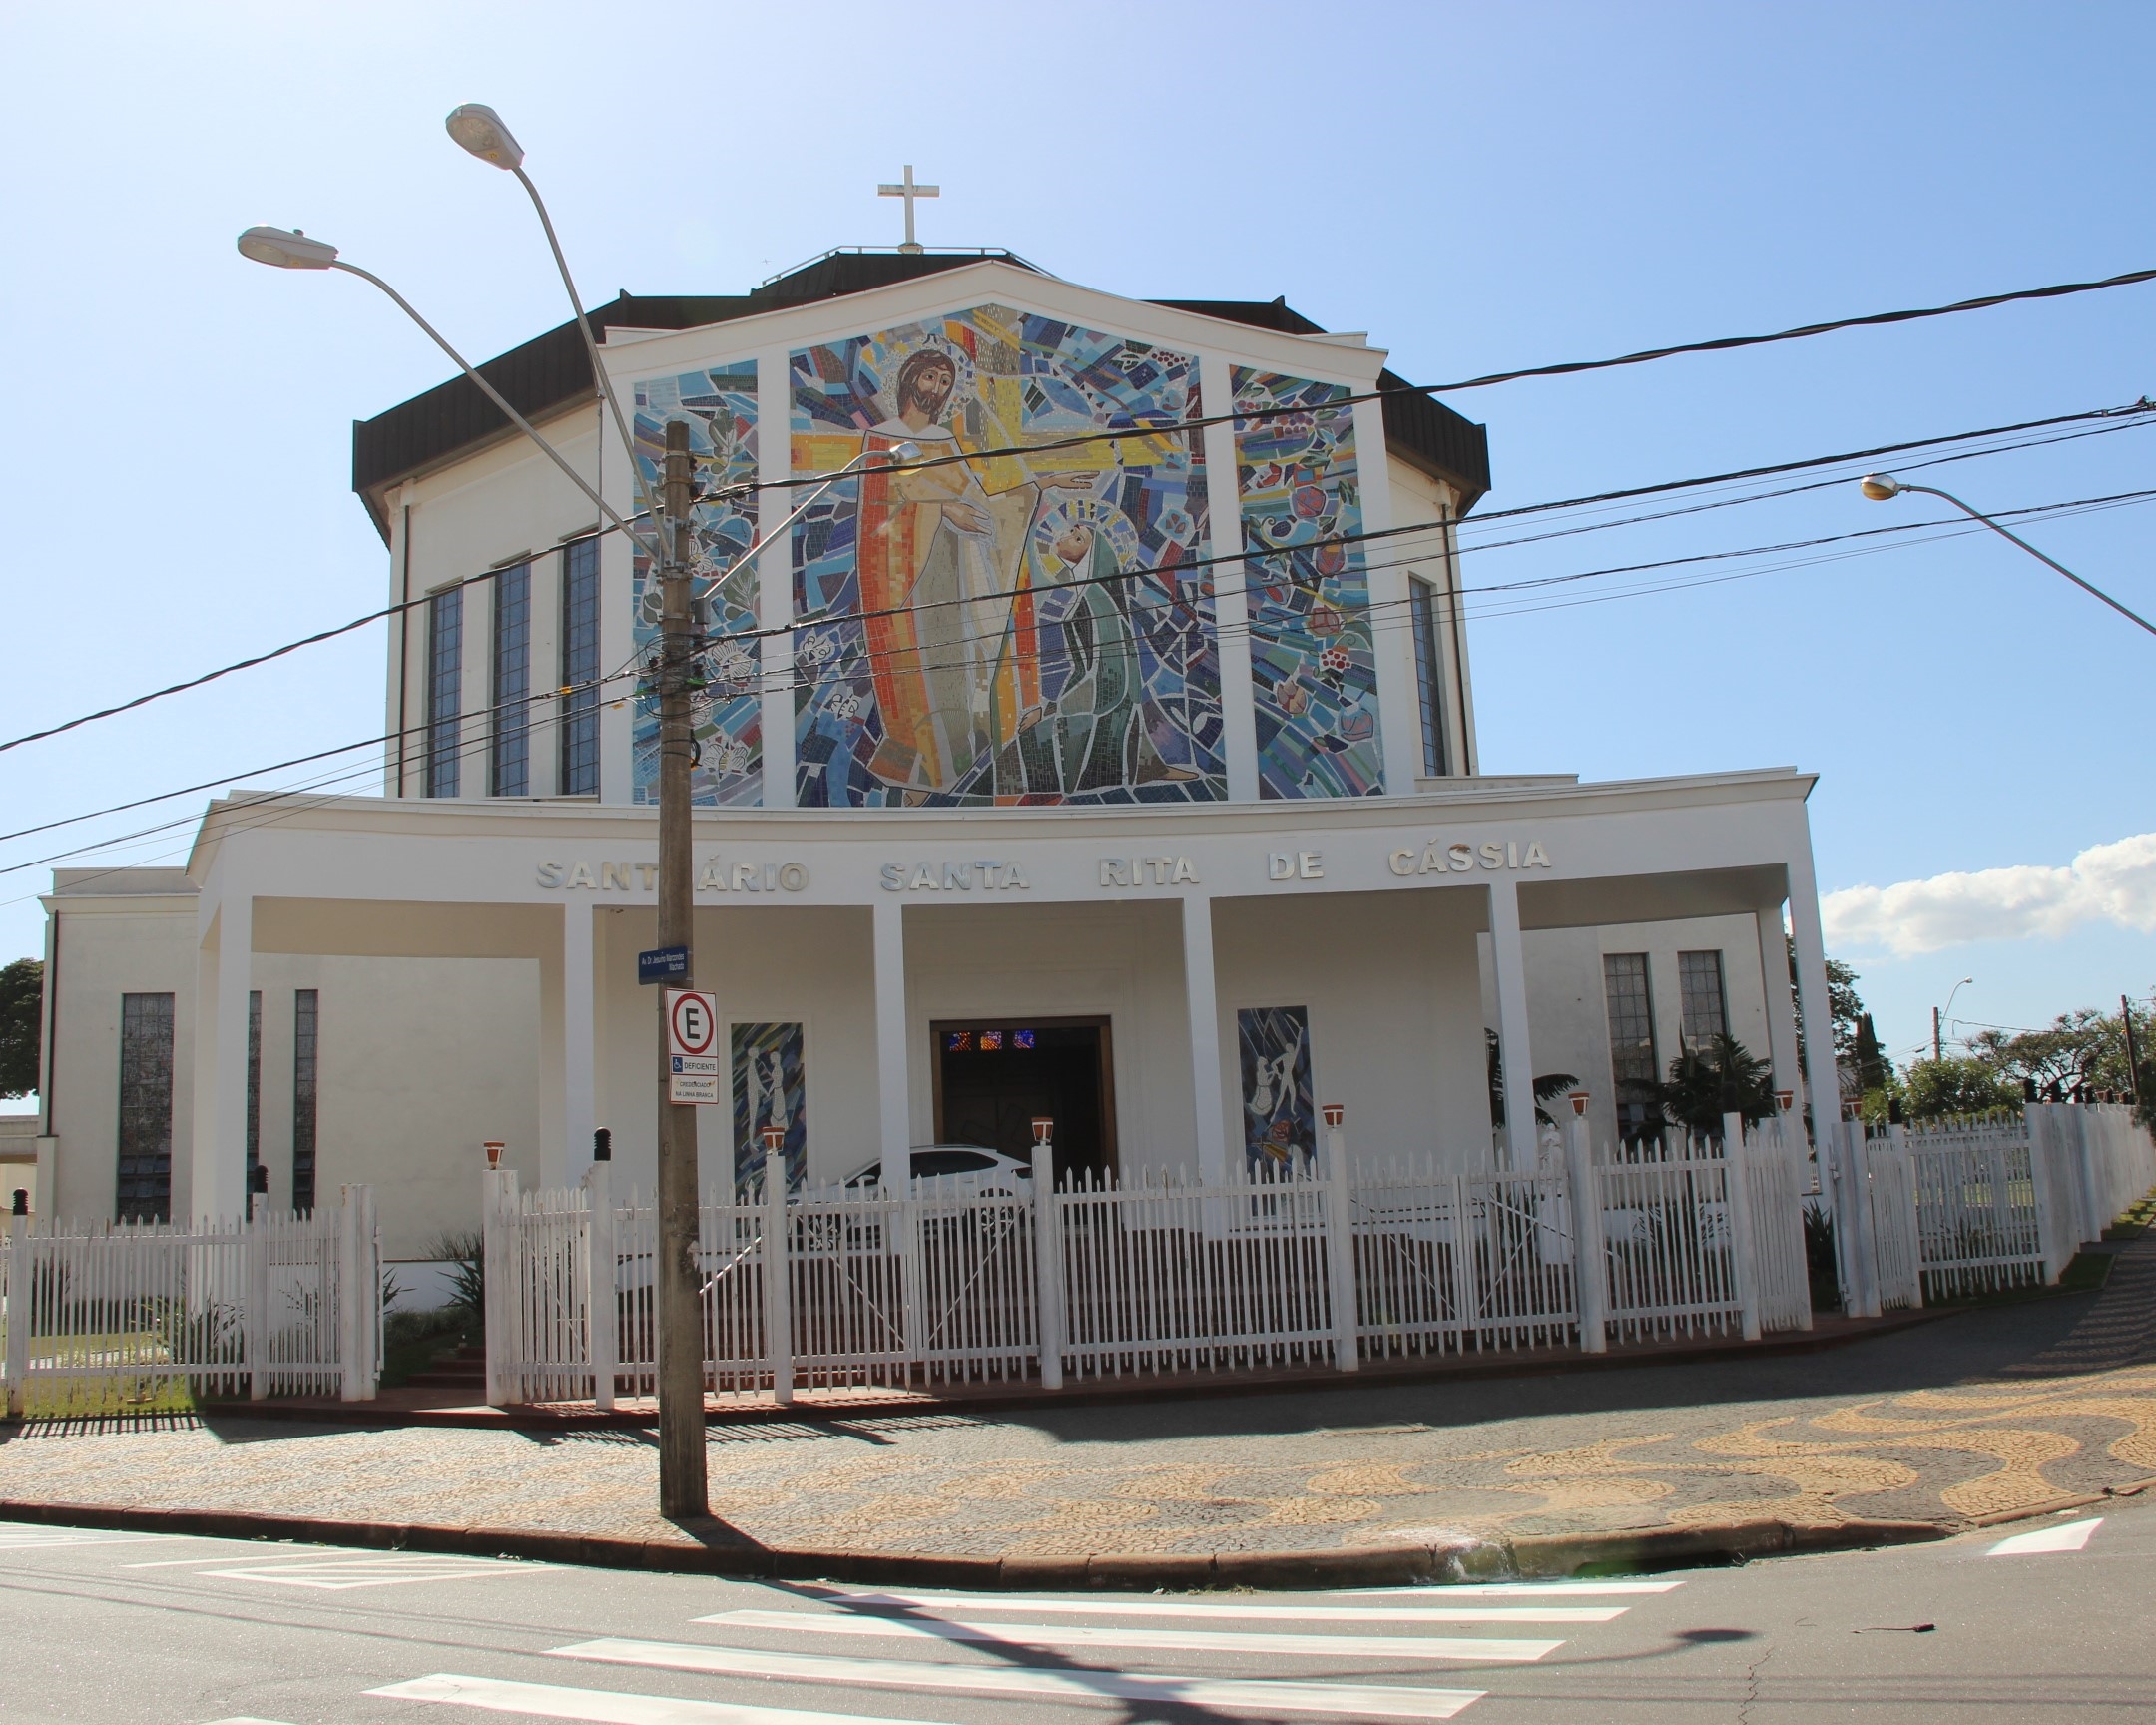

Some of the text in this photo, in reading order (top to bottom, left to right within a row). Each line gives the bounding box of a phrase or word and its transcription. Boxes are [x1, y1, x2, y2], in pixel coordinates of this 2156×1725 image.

[537, 838, 1551, 891] SANTÁRIO SANTA RITA DE CÁSSIA
[686, 1007, 701, 1039] E
[684, 1062, 716, 1071] DEFICIENTE
